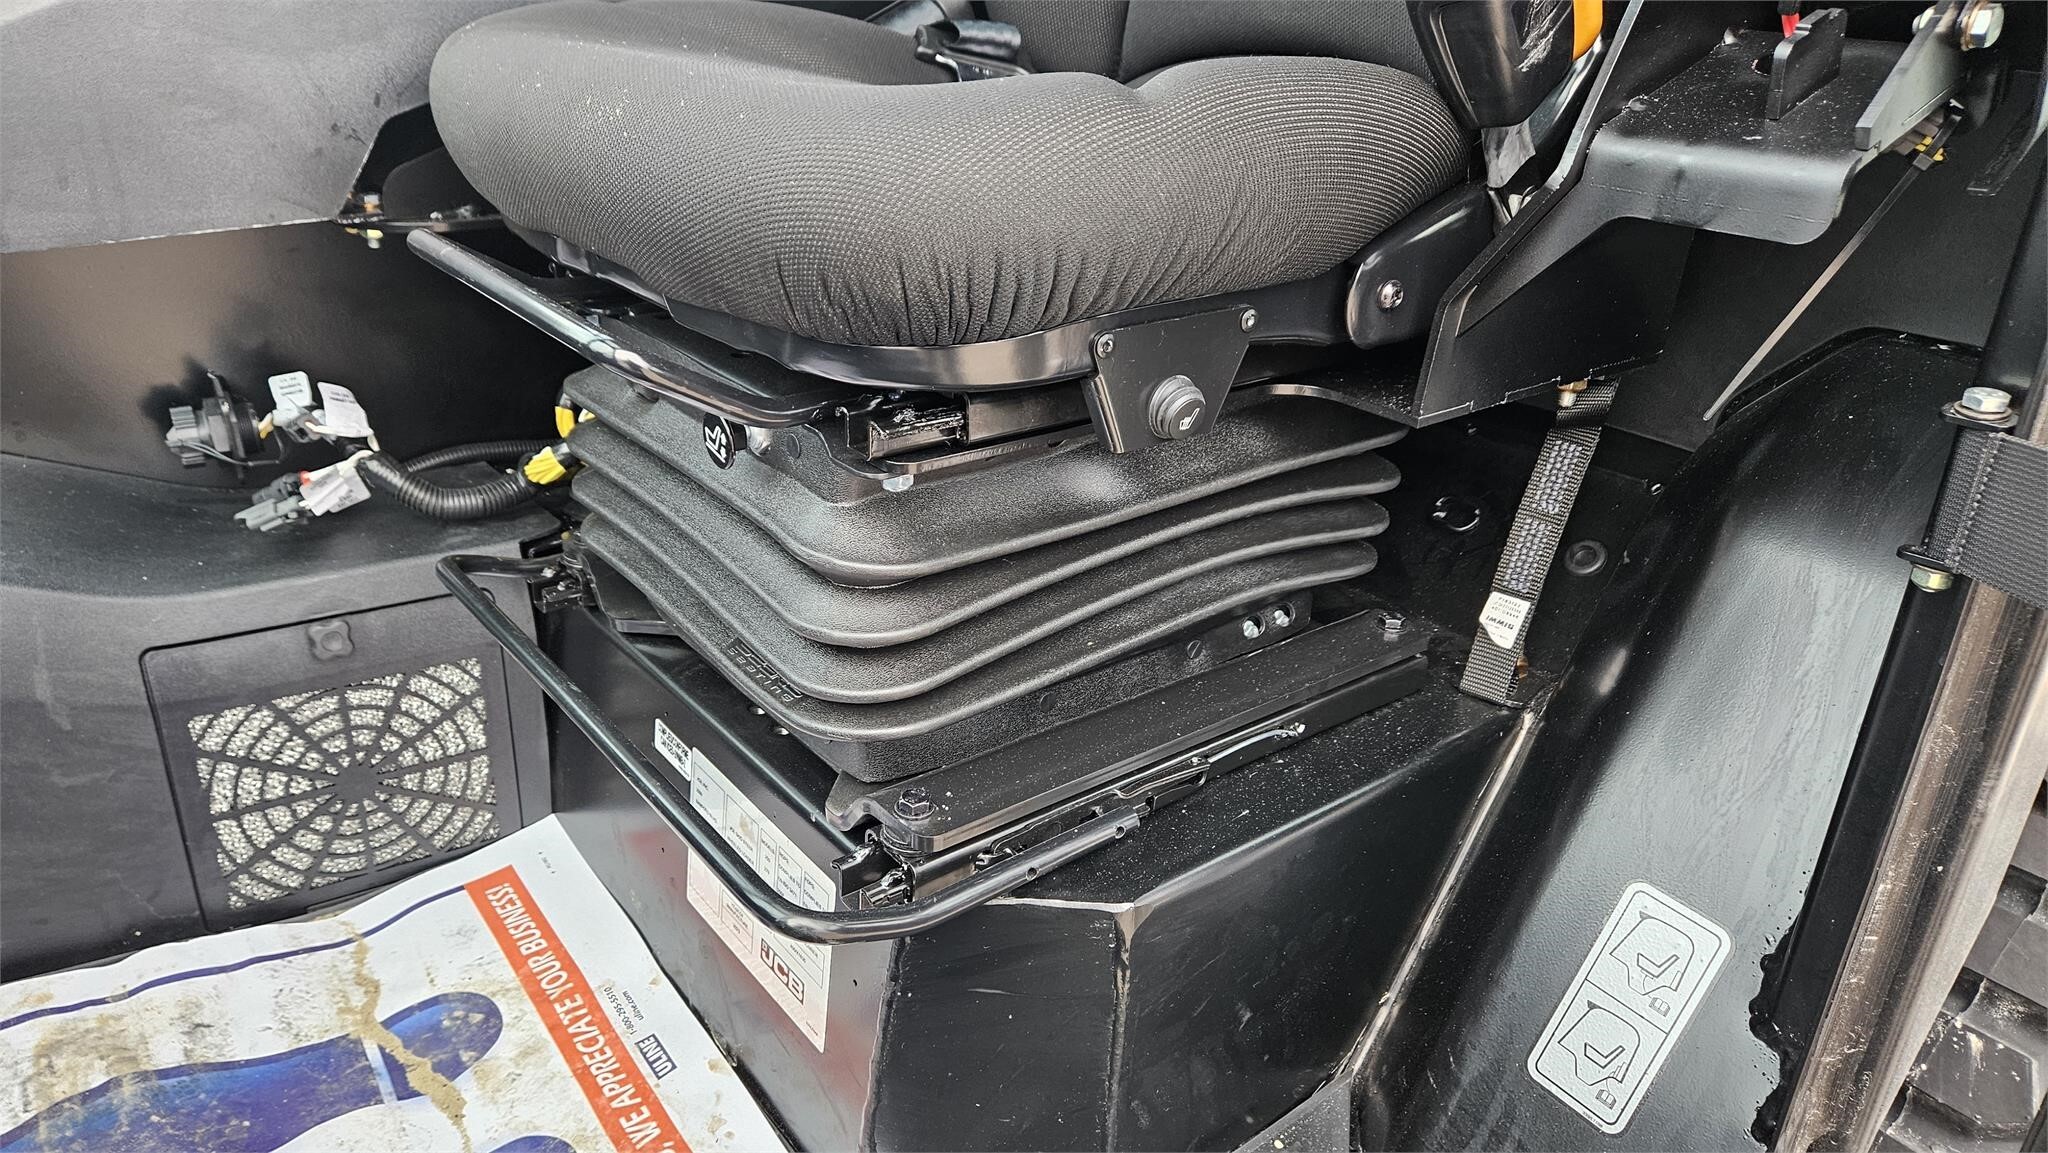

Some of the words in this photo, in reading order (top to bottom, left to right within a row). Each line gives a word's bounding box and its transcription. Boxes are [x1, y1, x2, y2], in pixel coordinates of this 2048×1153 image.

[485, 882, 548, 956] BUSINESS!
[527, 951, 575, 1001] YOUR
[761, 939, 804, 1004] JCB
[603, 986, 637, 1036] 1-800-295-5510
[622, 990, 644, 1021] uline.com
[554, 993, 643, 1109] APPRECIATE
[637, 1034, 674, 1077] ULINE
[619, 1105, 662, 1150] WE
